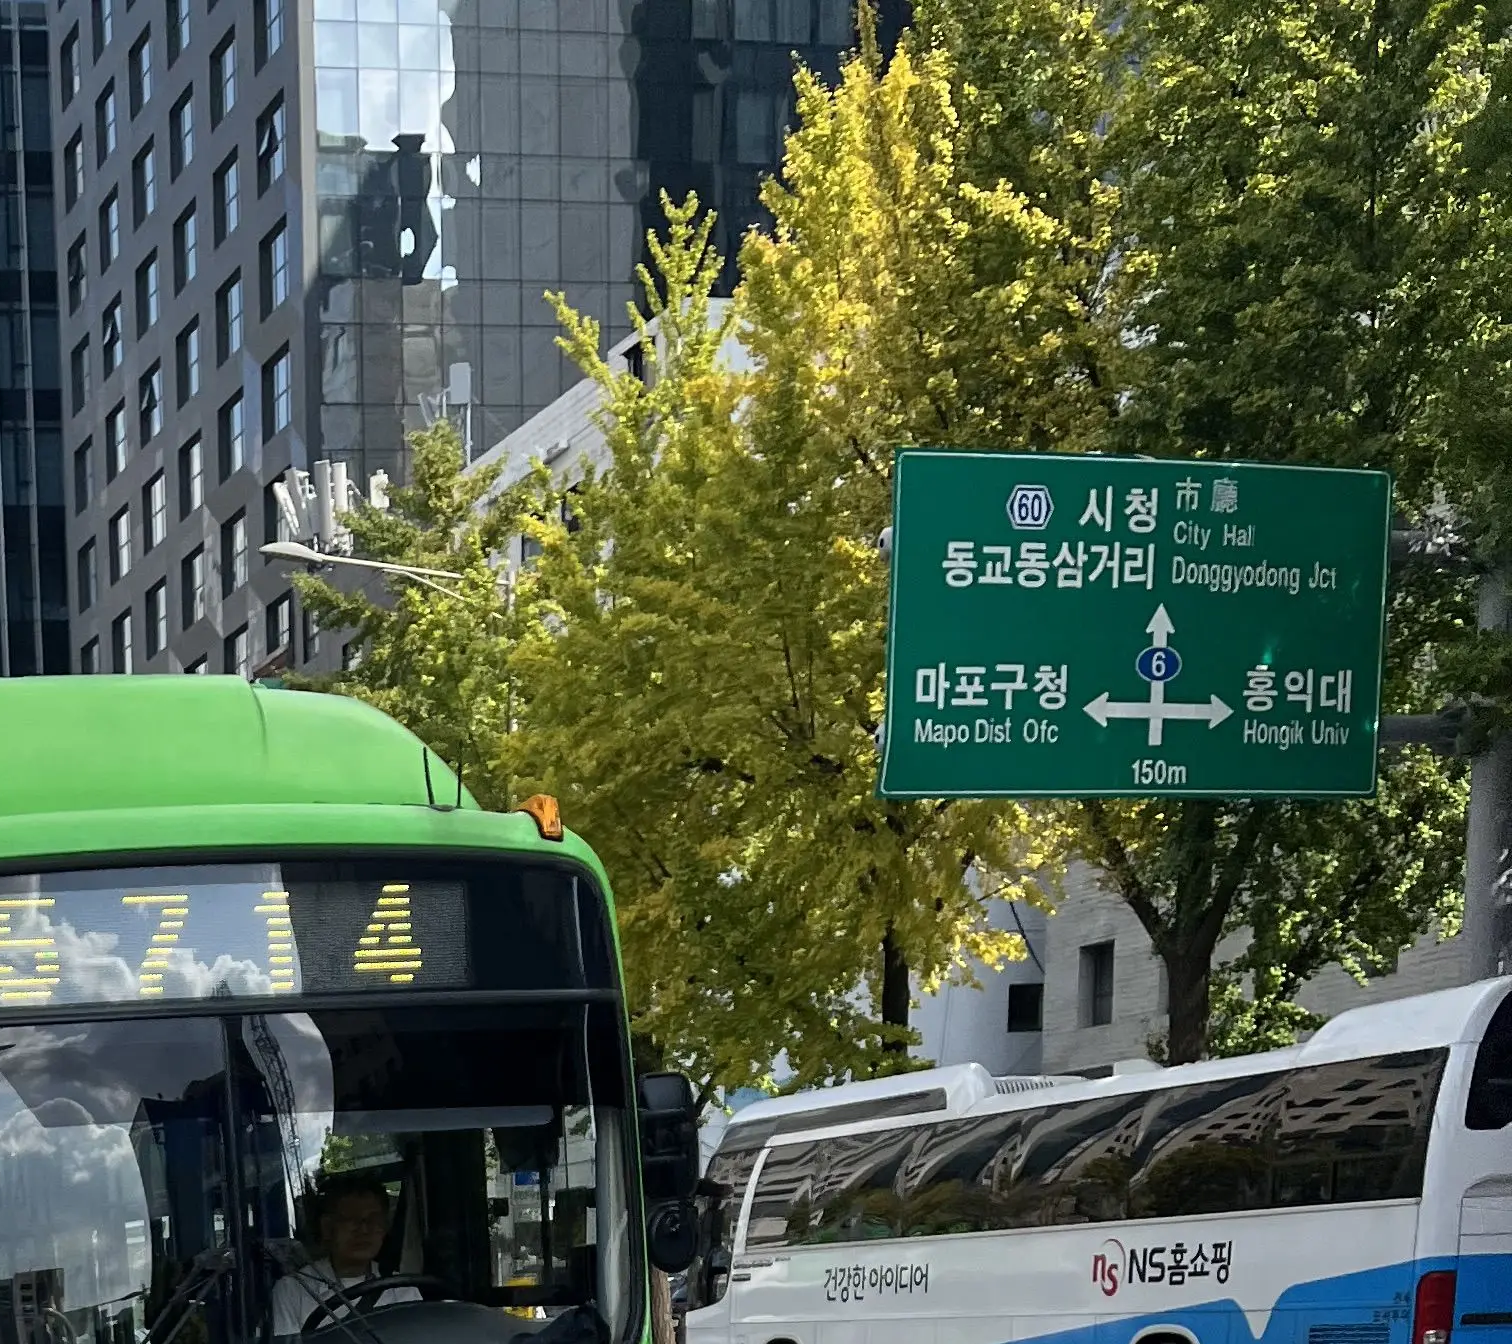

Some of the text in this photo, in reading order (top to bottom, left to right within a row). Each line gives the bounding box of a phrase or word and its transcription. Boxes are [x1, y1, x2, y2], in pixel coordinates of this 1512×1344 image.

[1018, 494, 1043, 522] 60
[1079, 486, 1159, 534] 시청
[1173, 521, 1256, 551] City Hall
[942, 541, 1156, 590] 동교동삼거리
[1172, 556, 1337, 594] Donggyodong Jct
[1151, 652, 1167, 678] 6
[915, 662, 1068, 711] 마포구청
[1242, 665, 1353, 713] 홍익대
[914, 717, 1059, 749] Mapo Dist Ofc
[1243, 719, 1350, 750] Hongik Univ
[1131, 759, 1187, 785] 150m
[1128, 1240, 1233, 1286] NS홈쇼핑
[823, 1263, 929, 1303] 건강한 아이디어
